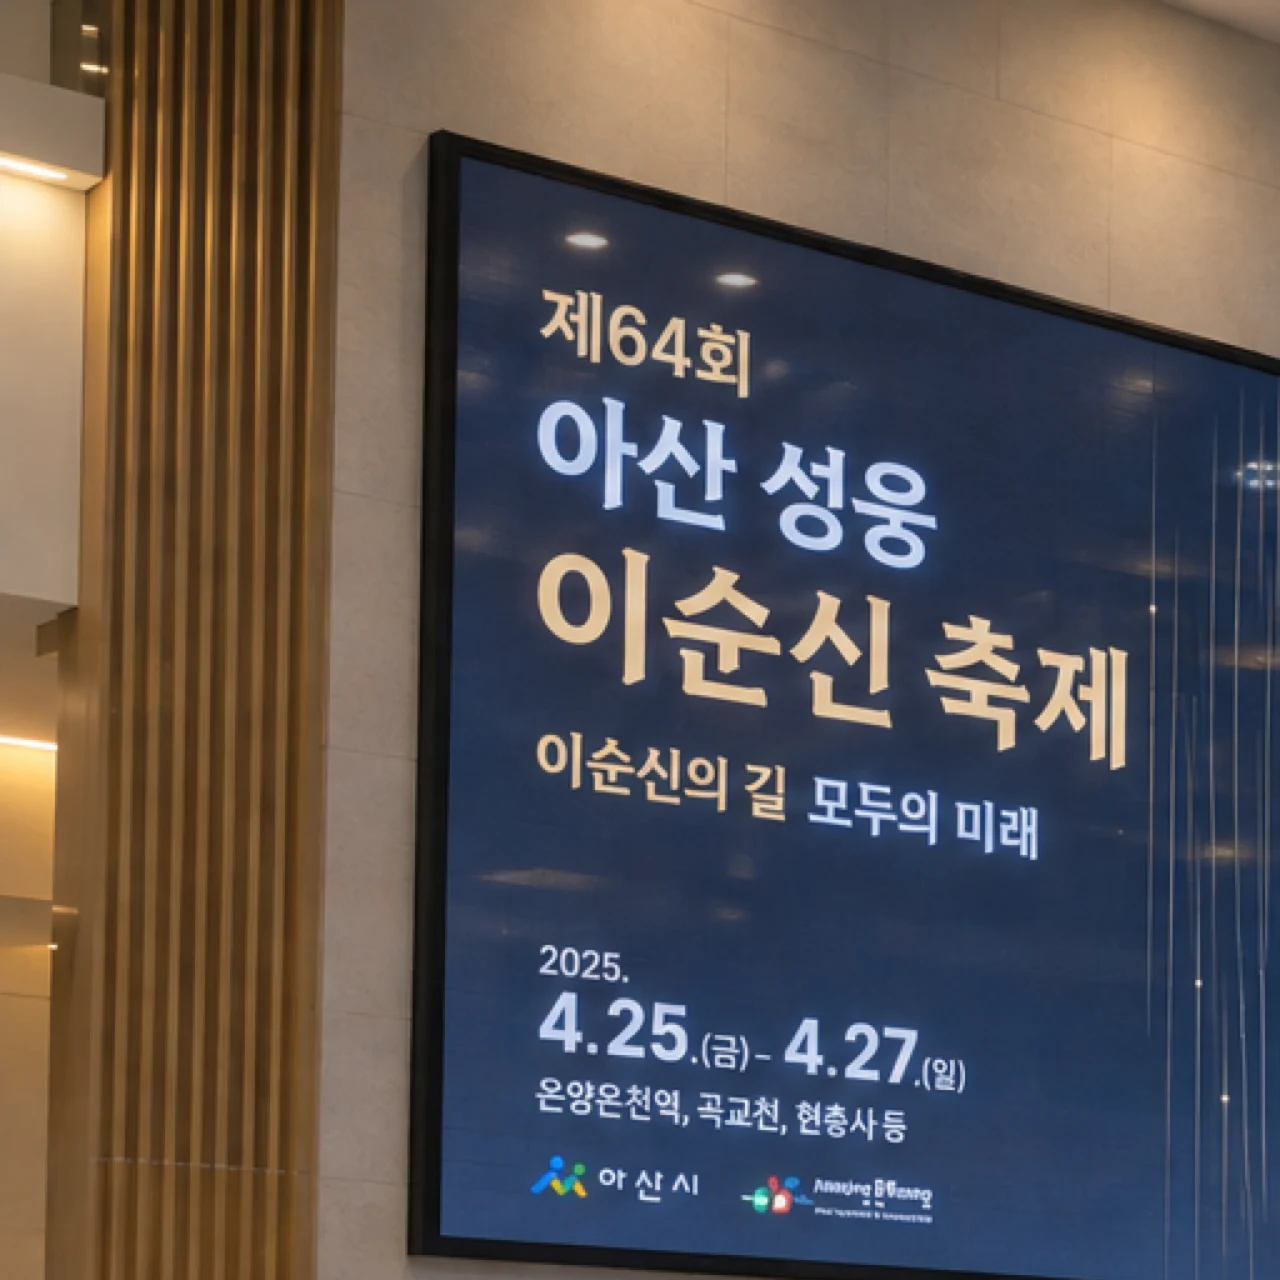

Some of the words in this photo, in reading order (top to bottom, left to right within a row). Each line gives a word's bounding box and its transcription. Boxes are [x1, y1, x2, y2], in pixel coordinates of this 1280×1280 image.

[540, 288, 752, 398] 제64회
[537, 397, 738, 531] 아산
[760, 440, 938, 570] 성웅
[537, 547, 895, 729] 이순신
[926, 613, 1129, 771] 축제
[536, 730, 729, 813] 이순신의
[745, 762, 787, 822] 길
[808, 775, 939, 846] 모두의
[956, 800, 1040, 861] 미래
[538, 945, 629, 983] 2025.
[536, 1077, 689, 1127] 온양온천역,
[696, 1092, 787, 1137] 곡교천,
